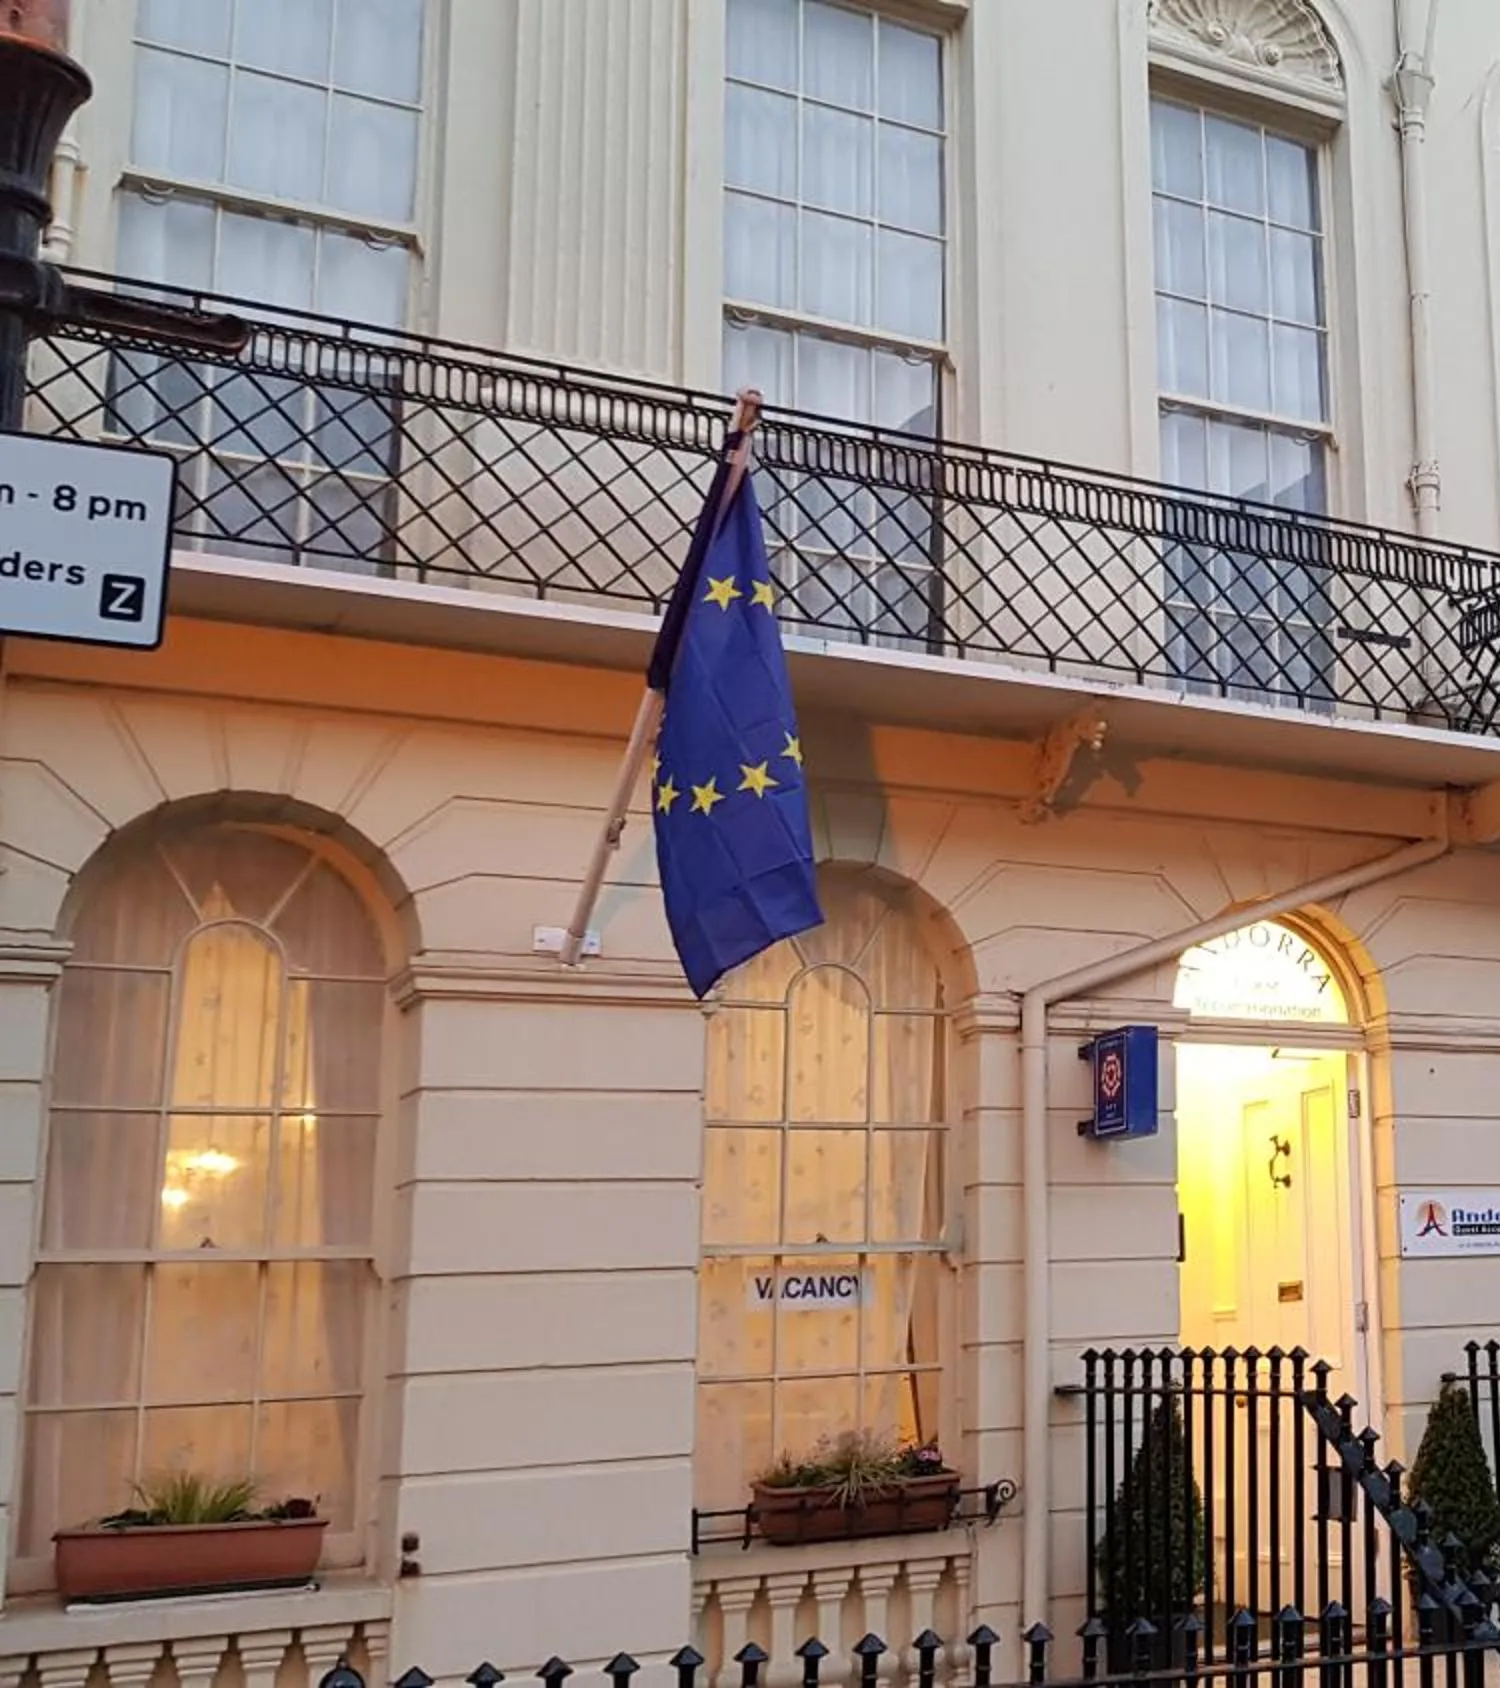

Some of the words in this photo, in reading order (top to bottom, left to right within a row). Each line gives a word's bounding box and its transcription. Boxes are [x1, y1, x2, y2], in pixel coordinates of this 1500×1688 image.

[53, 484, 77, 511] 8
[88, 495, 147, 521] pm
[108, 581, 137, 614] Z
[1179, 925, 1331, 994] DORRA
